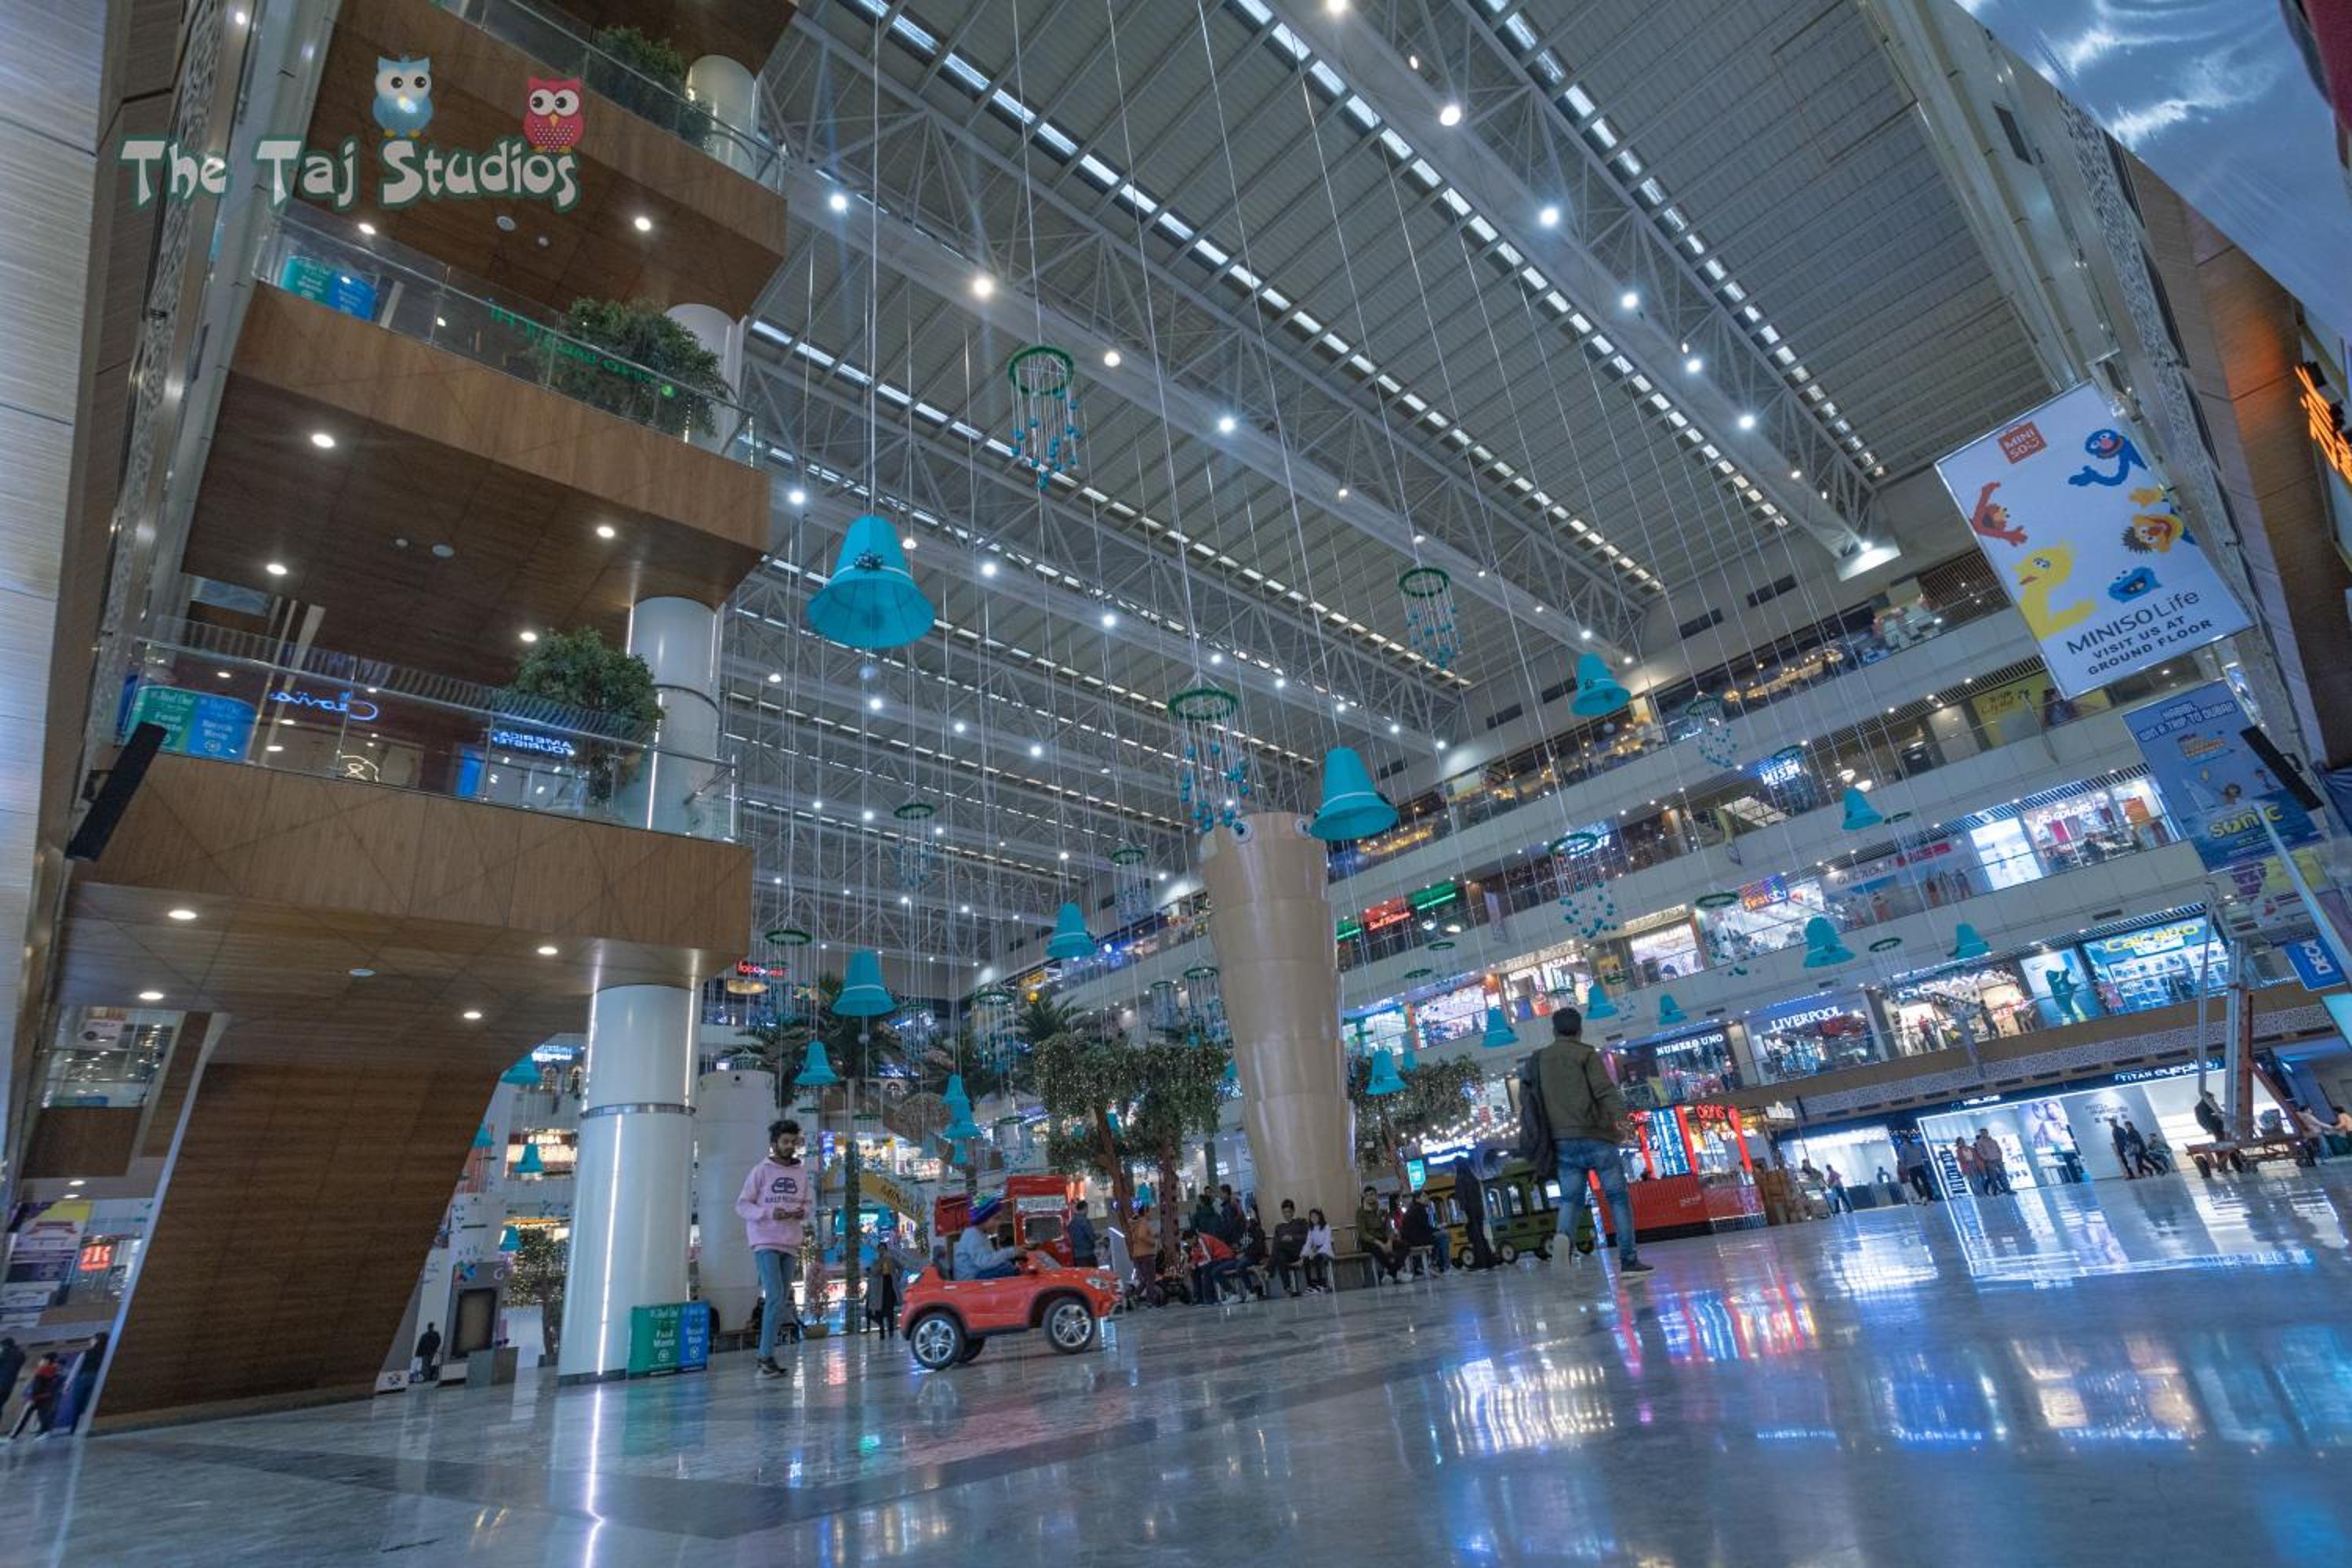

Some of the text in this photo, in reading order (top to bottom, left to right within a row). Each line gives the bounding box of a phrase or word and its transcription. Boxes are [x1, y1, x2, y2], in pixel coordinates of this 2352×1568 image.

[2004, 428, 2035, 449] MINI
[2088, 619, 2213, 675] GROUND FLOOR
[2092, 615, 2185, 659] VISIT US AT
[1771, 1006, 1844, 1030] LIVERPOOL
[1655, 1033, 1724, 1055] NUMERO UNO
